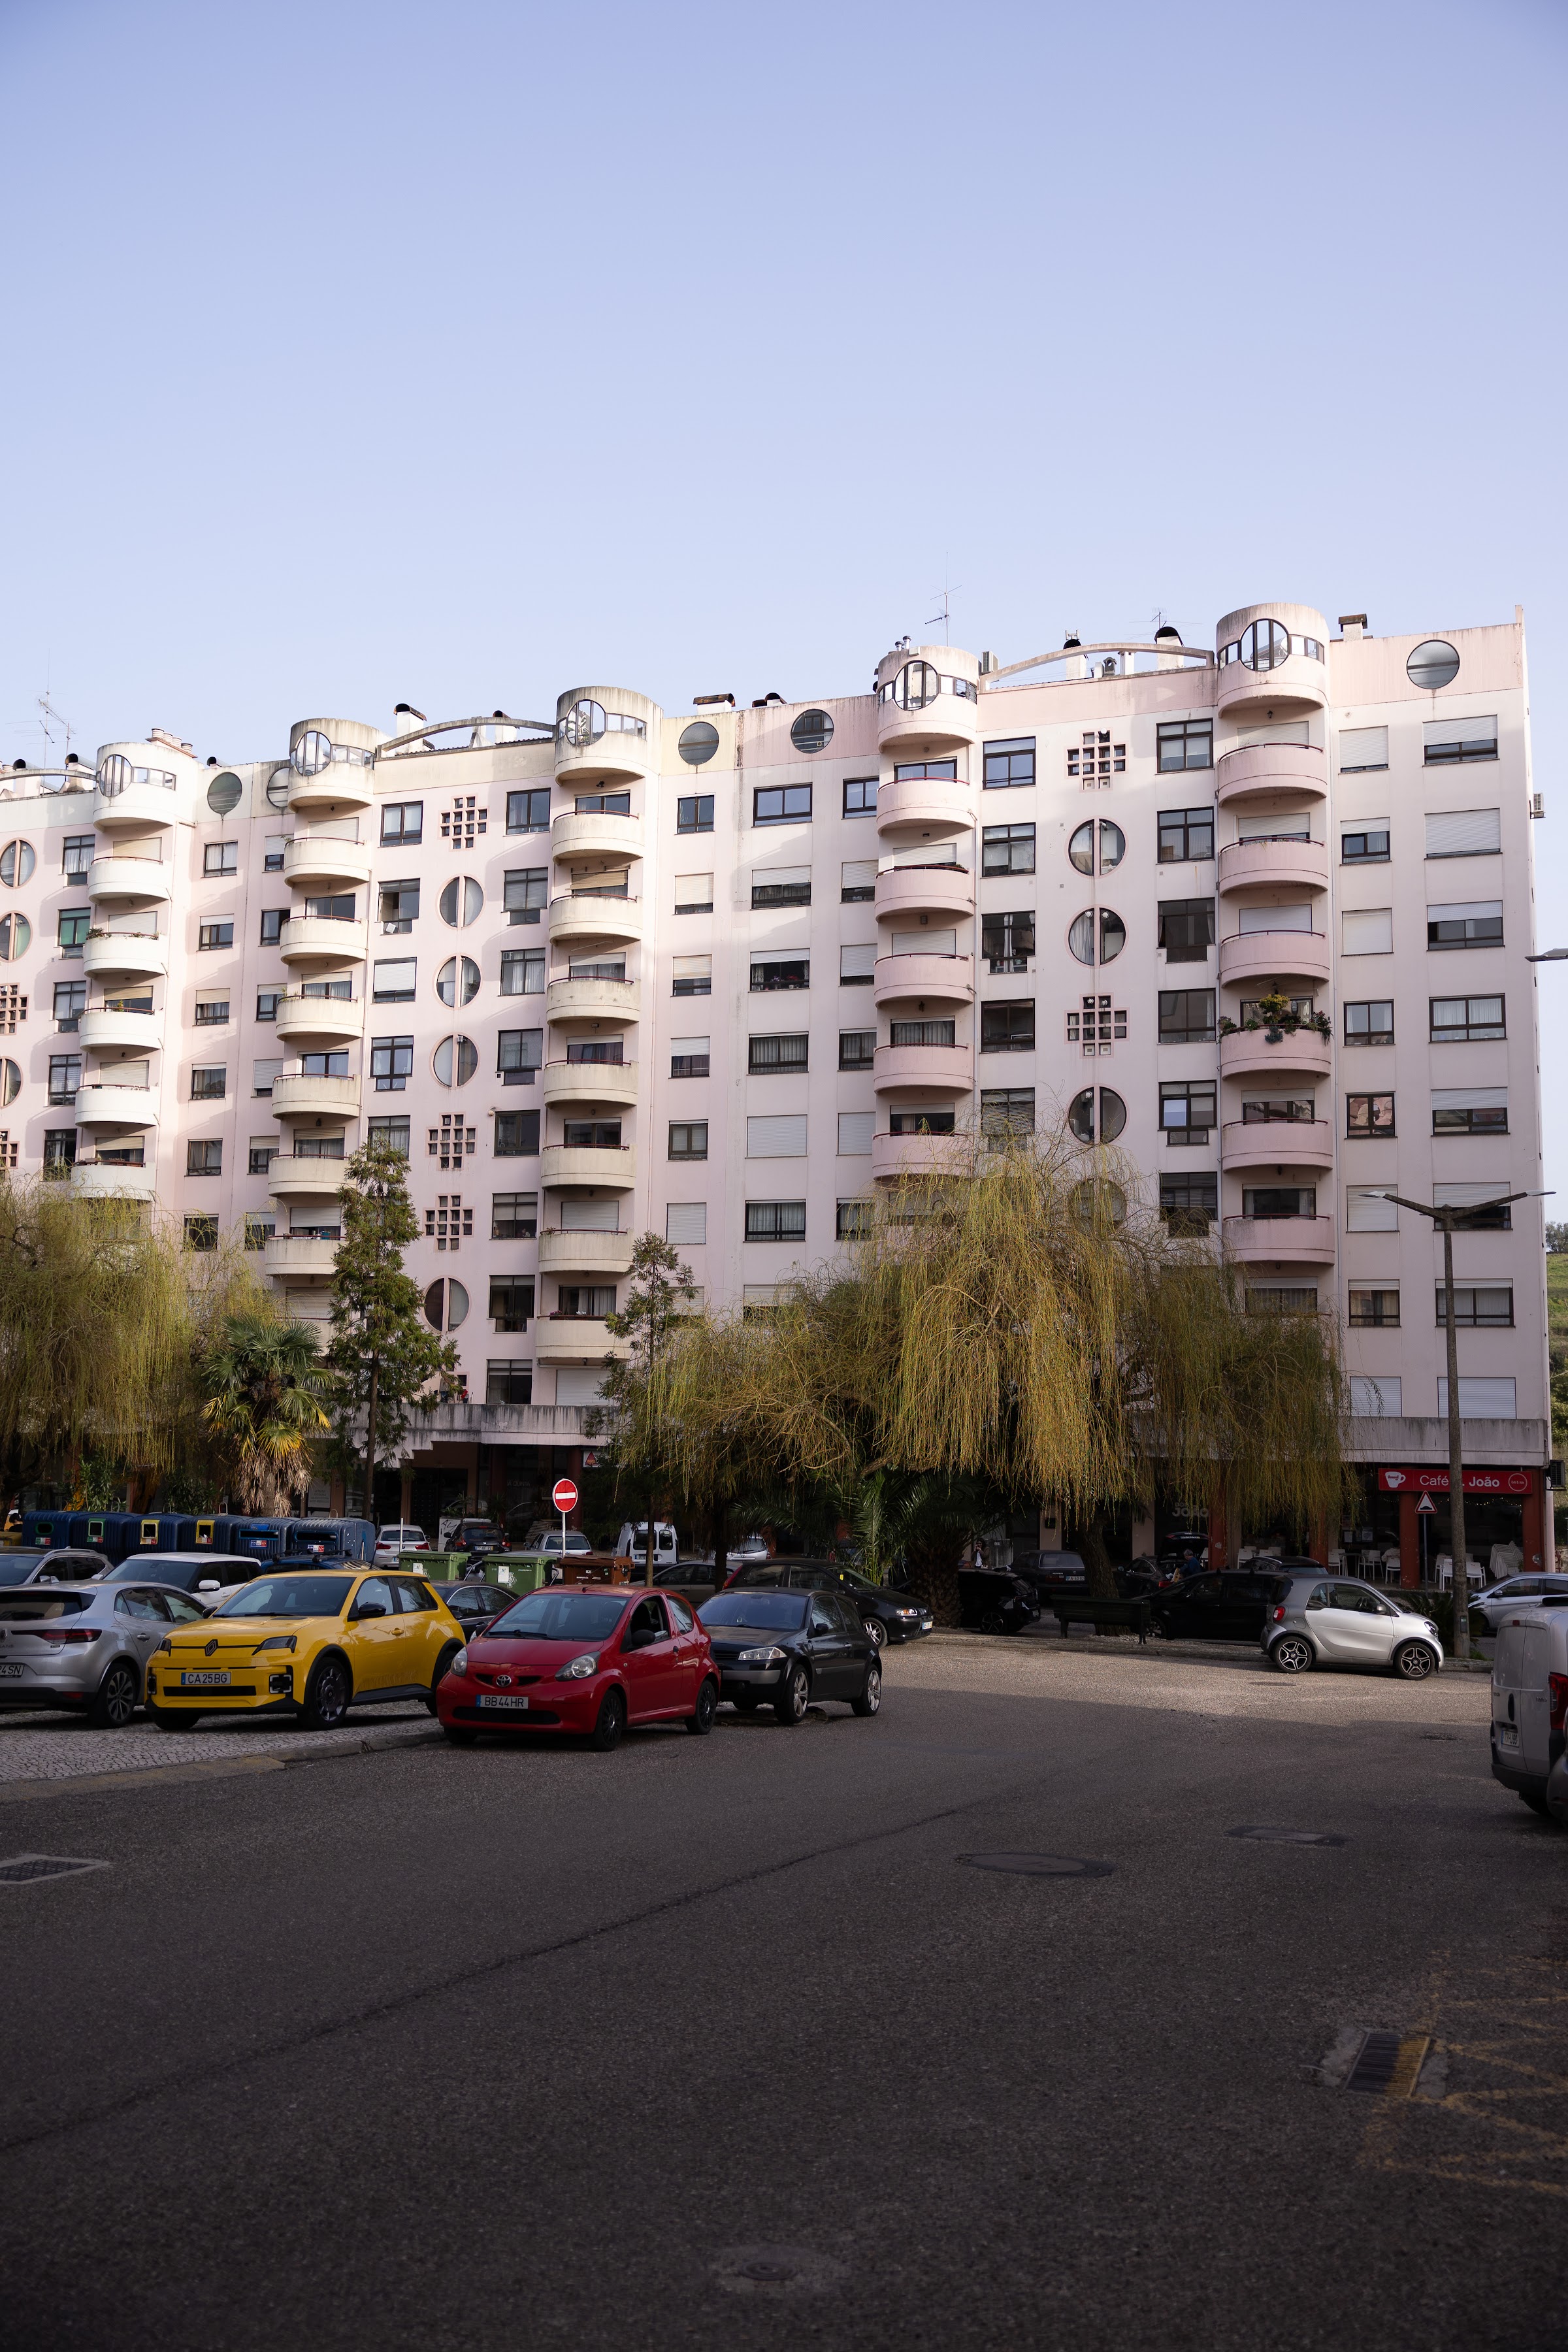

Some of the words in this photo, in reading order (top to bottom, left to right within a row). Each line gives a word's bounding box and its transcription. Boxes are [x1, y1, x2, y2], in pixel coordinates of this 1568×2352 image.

[1420, 1475, 1449, 1486] Café
[1469, 1477, 1500, 1488] João
[8, 1665, 21, 1674] SN
